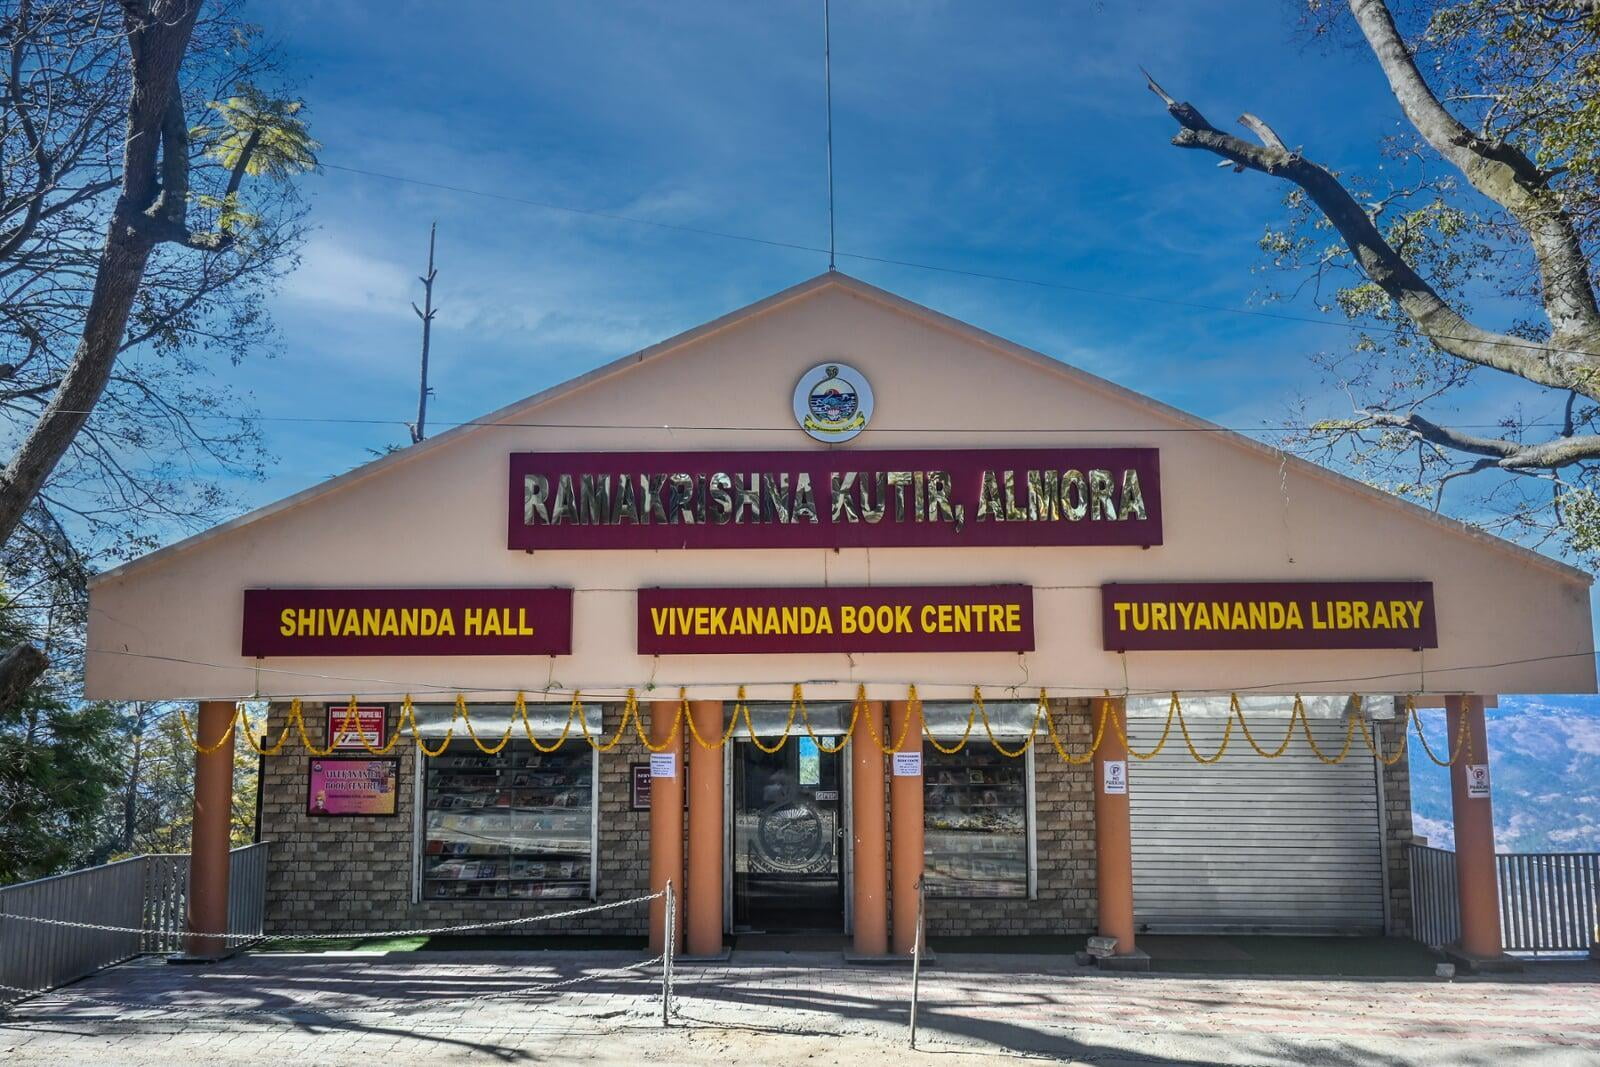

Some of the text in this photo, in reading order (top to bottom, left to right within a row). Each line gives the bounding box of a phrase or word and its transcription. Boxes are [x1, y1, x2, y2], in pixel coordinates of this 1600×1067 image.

[524, 468, 1148, 534] RAMAKRISHNA KUTIR, ALMORA
[280, 607, 534, 637] SHIVANANDA HALL
[651, 604, 1021, 635] VIVEKANANDA BOOK CENTRE
[1114, 600, 1425, 631] TURIYANANDA LIBRARY
